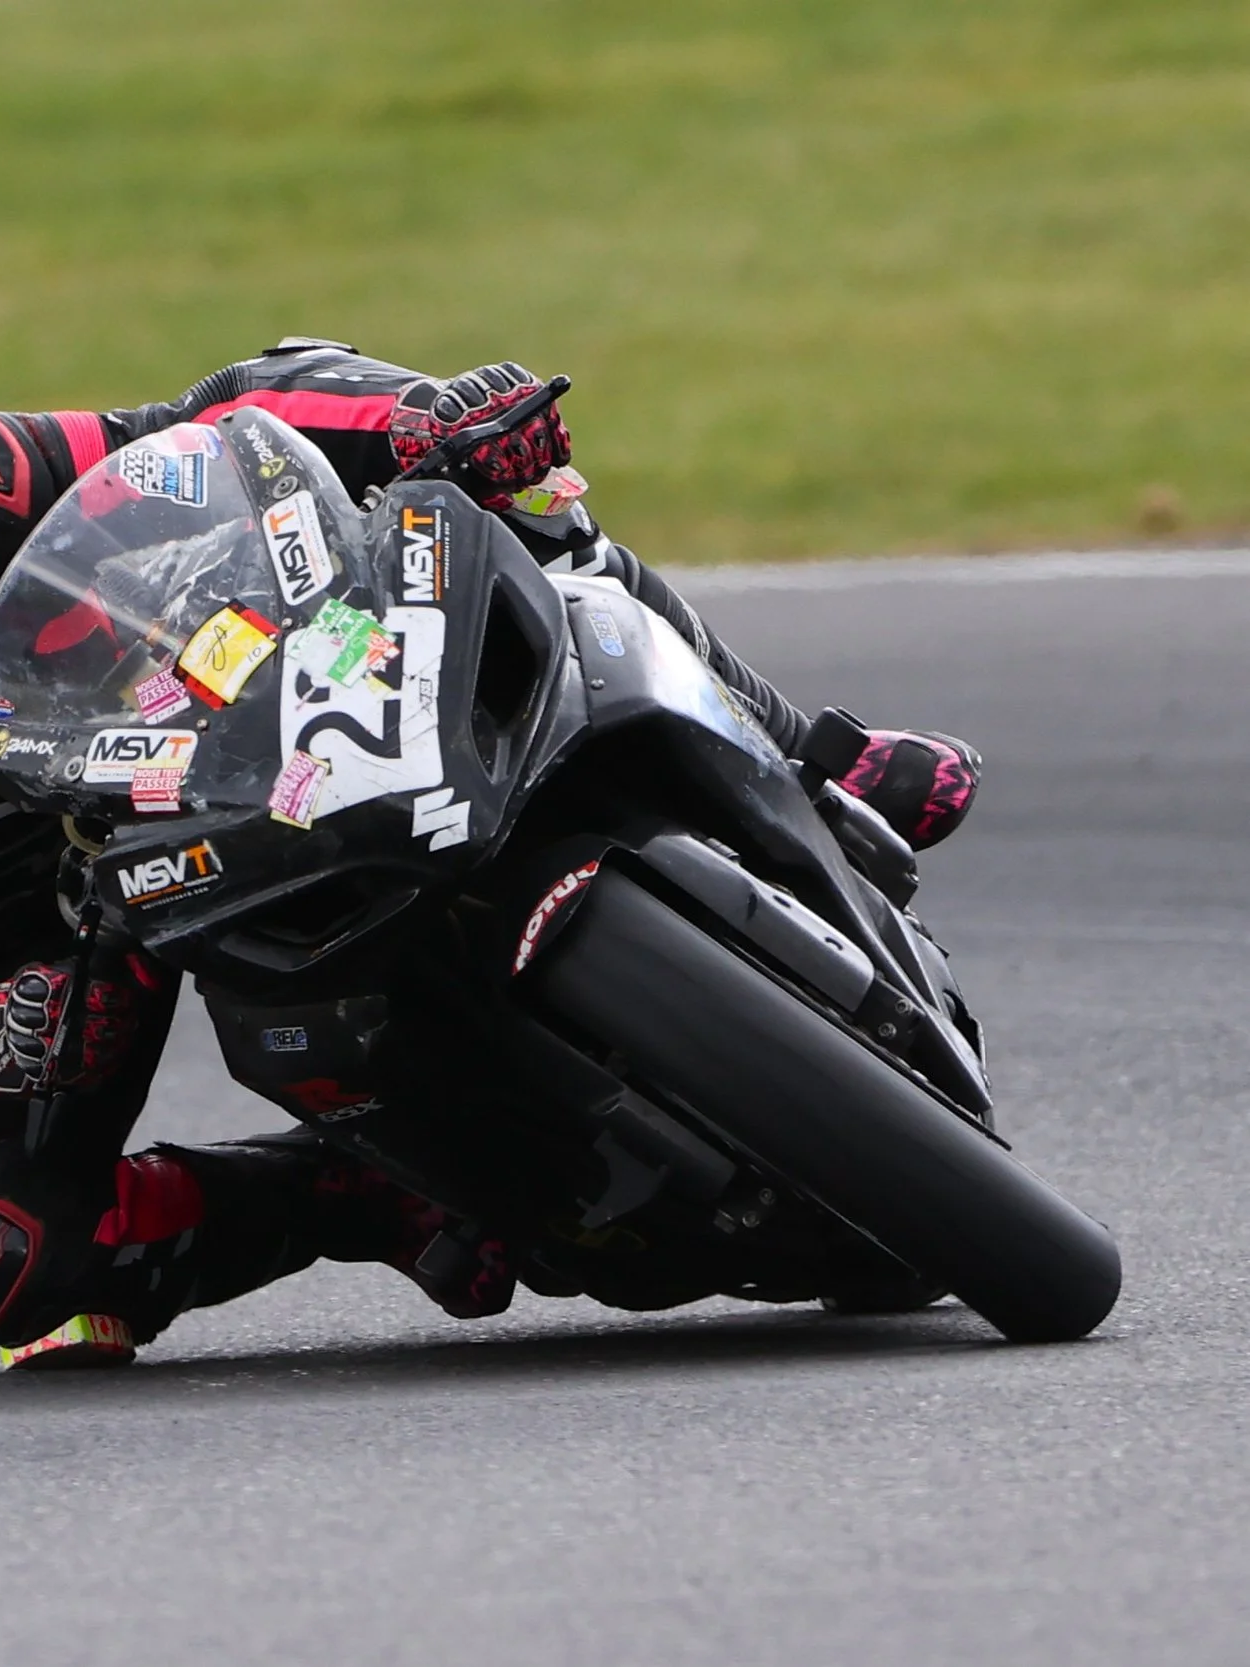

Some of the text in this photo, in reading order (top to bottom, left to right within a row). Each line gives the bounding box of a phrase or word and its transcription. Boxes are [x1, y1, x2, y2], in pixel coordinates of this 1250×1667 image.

[267, 510, 316, 601] MSVT
[403, 507, 434, 601] MSVT
[140, 679, 181, 706] PASSED
[6, 738, 58, 755] 24MX
[91, 736, 193, 761] MSVT
[134, 779, 178, 789] PASSED
[136, 769, 161, 778] NOISE
[161, 768, 182, 777] TEST
[118, 845, 208, 899] MSVT
